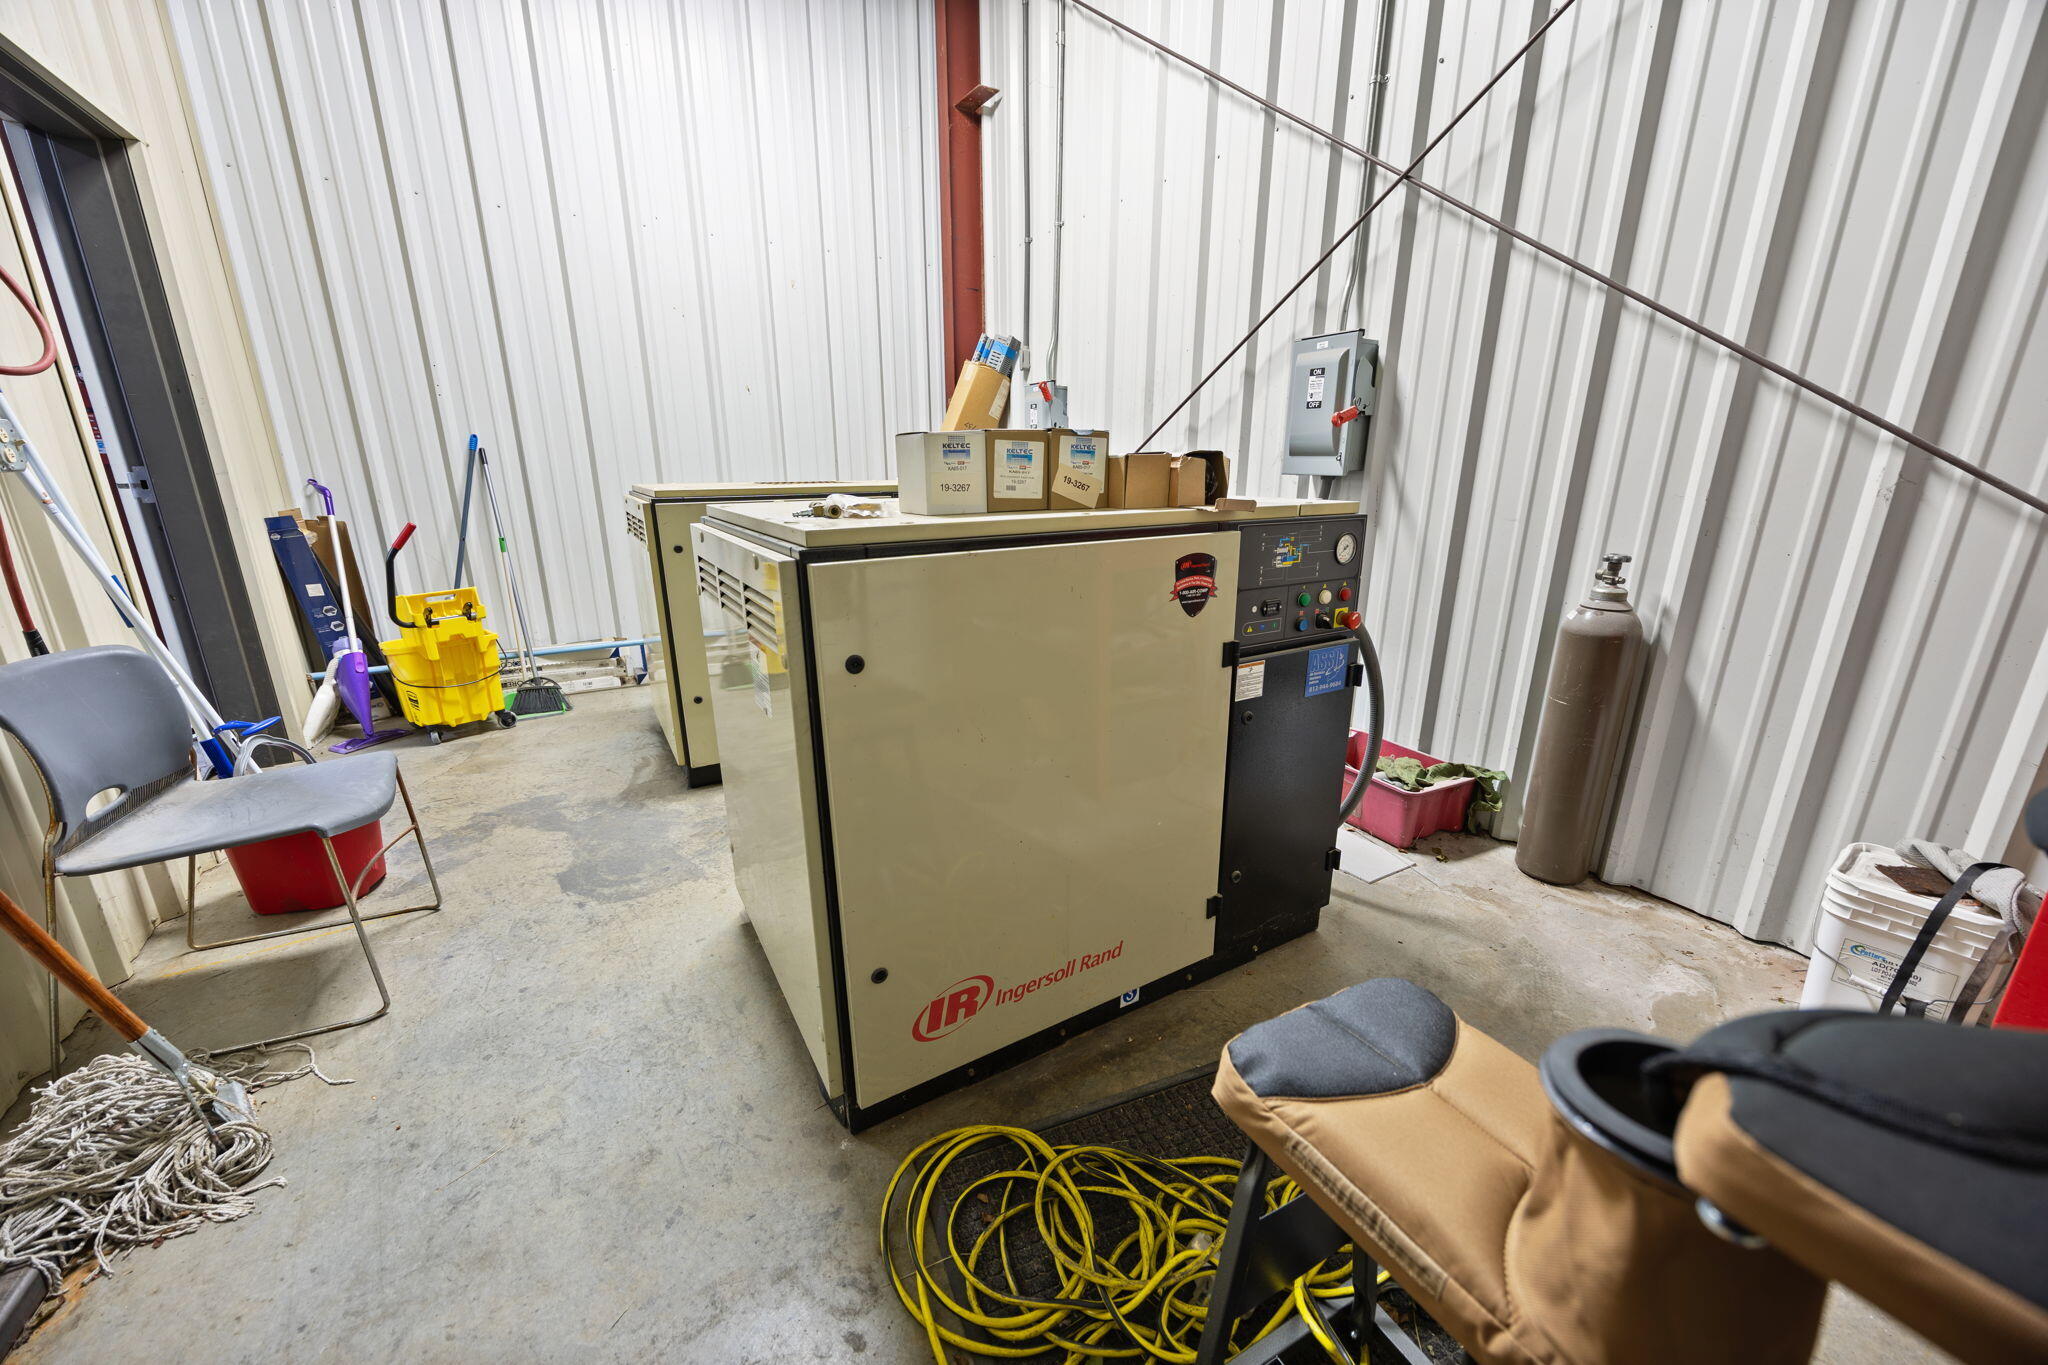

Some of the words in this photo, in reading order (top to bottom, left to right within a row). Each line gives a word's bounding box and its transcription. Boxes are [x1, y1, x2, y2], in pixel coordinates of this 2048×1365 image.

[940, 483, 971, 492] 19-3267
[1063, 475, 1091, 492] 19-3267
[924, 984, 982, 1036] IR
[995, 958, 1076, 1007] Ingersoll
[1078, 939, 1124, 973] Rand
